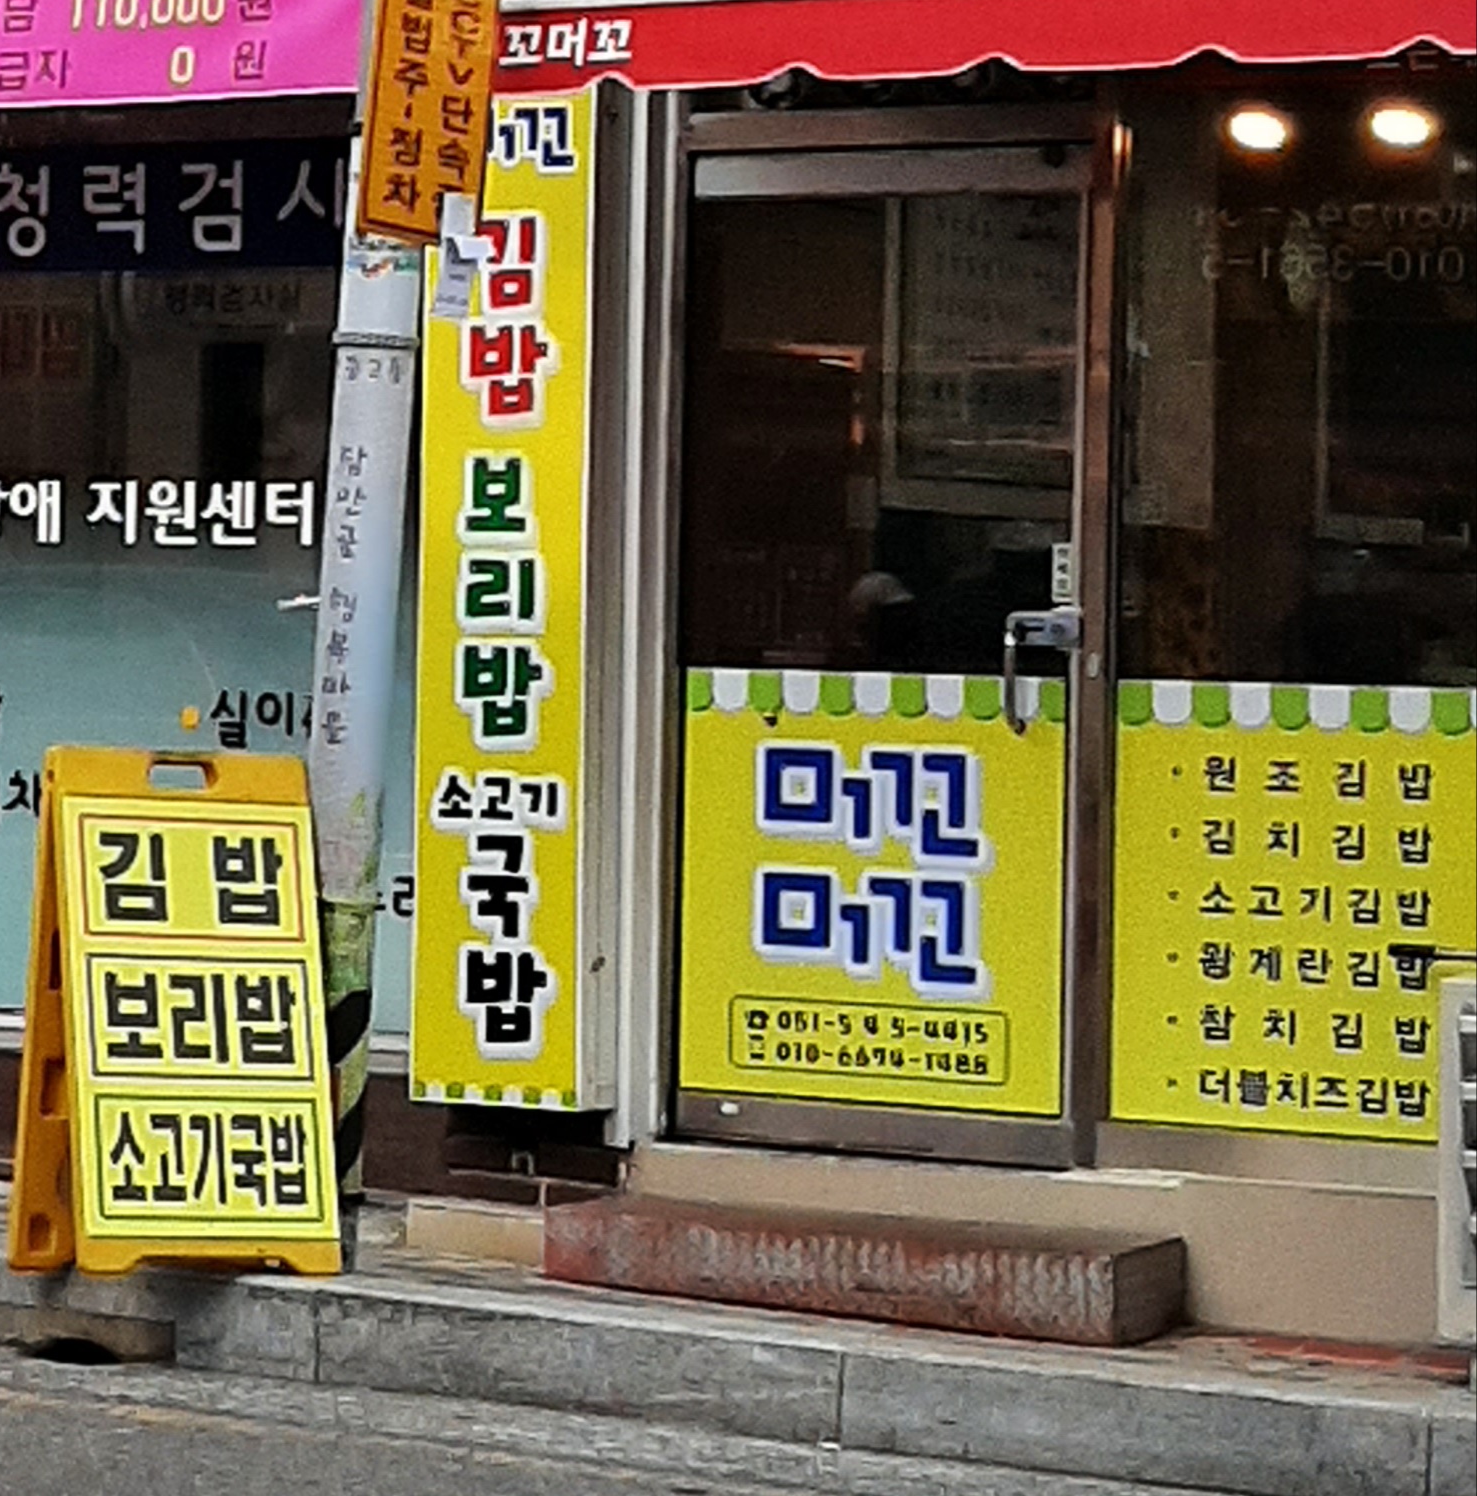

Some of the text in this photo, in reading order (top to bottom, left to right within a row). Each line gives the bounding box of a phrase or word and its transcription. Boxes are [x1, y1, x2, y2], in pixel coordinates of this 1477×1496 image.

[168, 45, 195, 87] 0
[233, 39, 268, 81] 원
[87, 478, 316, 548] 지원센터
[462, 457, 544, 740] 보리밥
[209, 688, 315, 749] 실이
[437, 773, 560, 821] 소고기
[465, 833, 549, 1044] 국밥
[104, 970, 299, 1066] 보리밥
[109, 1109, 310, 1207] 소고기국밥
